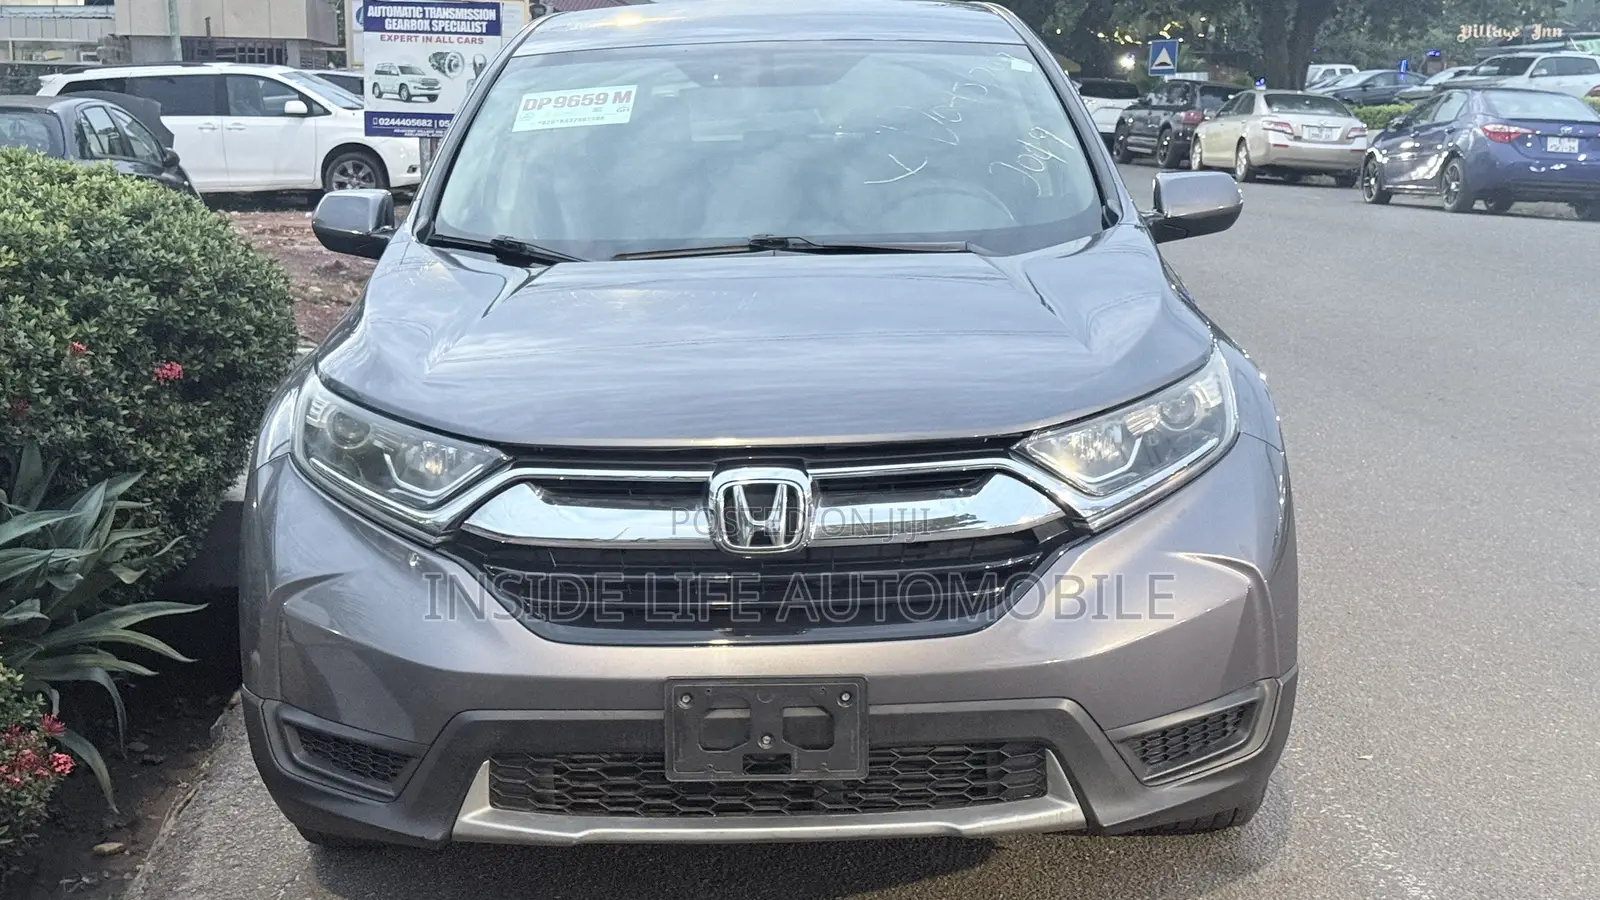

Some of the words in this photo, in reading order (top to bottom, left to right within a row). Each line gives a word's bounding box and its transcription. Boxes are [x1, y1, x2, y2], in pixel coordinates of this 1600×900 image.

[367, 6, 423, 19] AUTOMATIC
[424, 7, 497, 21] TRANSMISSION
[384, 18, 431, 31] GEARBOX
[431, 20, 488, 33] SPECIALIST
[1531, 23, 1563, 40] Inn
[380, 34, 418, 43] EXPERT
[422, 35, 433, 43] IN
[435, 36, 454, 44] ALL
[457, 37, 484, 45] CARS
[522, 97, 552, 111] DP
[552, 92, 609, 109] 9659
[611, 90, 633, 104] M
